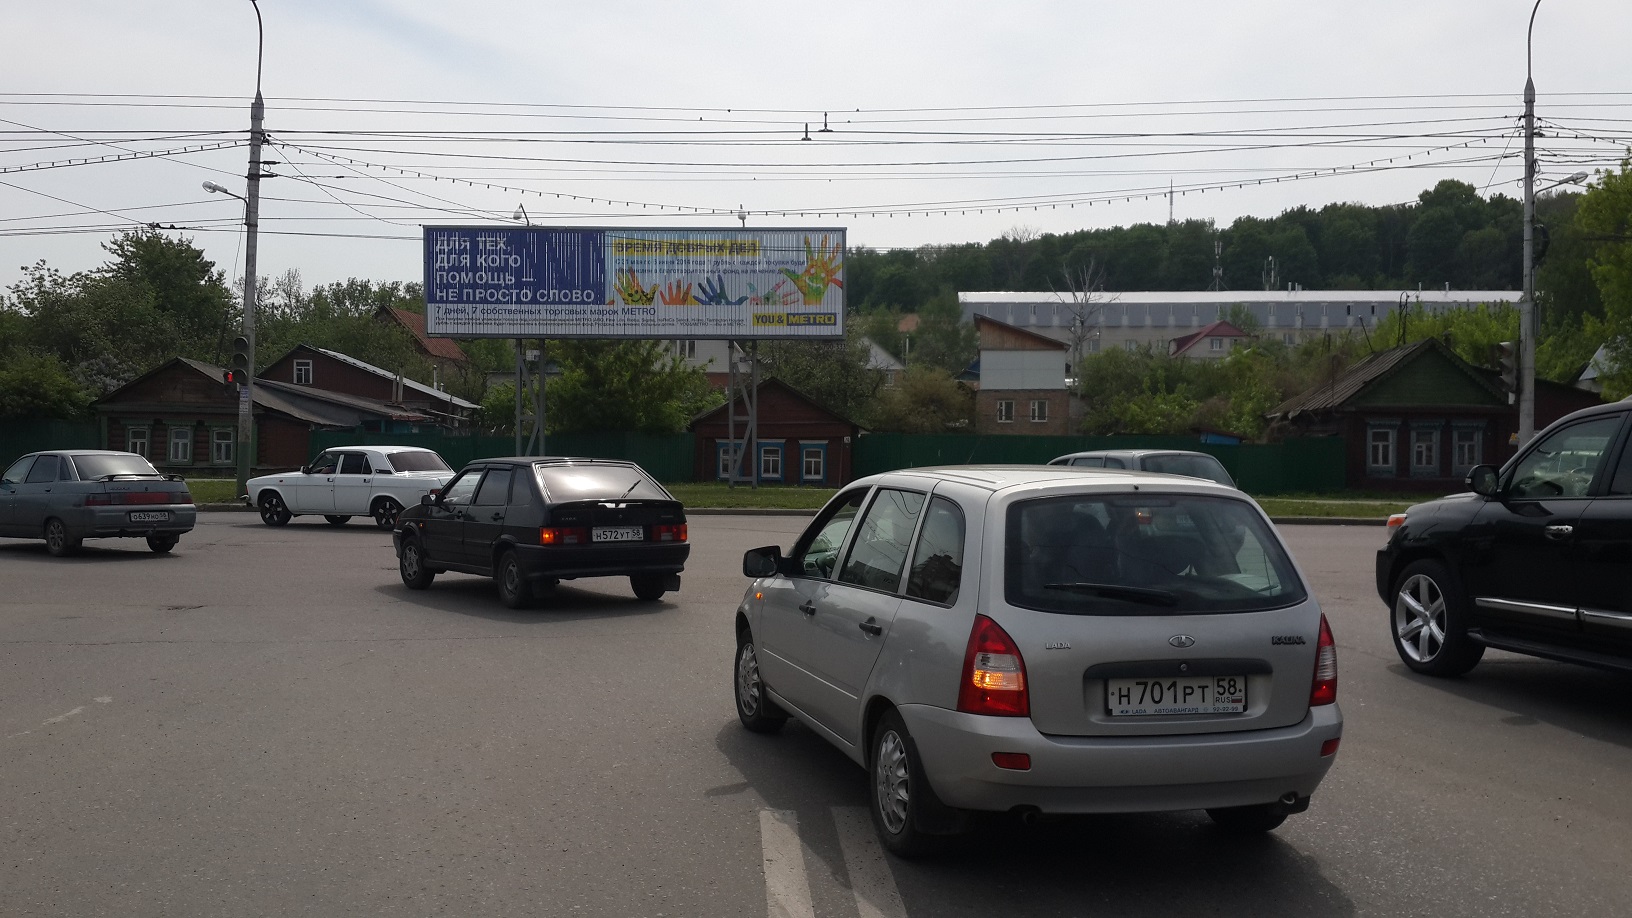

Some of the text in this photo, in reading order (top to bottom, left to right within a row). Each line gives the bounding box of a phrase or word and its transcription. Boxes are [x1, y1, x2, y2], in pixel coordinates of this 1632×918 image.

[435, 237, 511, 252] ДЛЯ ТЕХ,
[435, 254, 521, 269] ДЛЯ КОГО
[436, 271, 516, 286] ПОМОЩЬ
[436, 289, 595, 303] НЕ ПРОСТО СЛОВО
[435, 306, 442, 315] 7
[443, 306, 470, 316] дней,
[472, 306, 478, 315] 7
[480, 307, 542, 316] собственных
[544, 308, 587, 318] торговых
[589, 309, 619, 319] марок
[621, 307, 656, 316] METRO
[755, 314, 774, 324] YOU
[777, 314, 784, 324] &
[788, 314, 835, 324] METRO
[1045, 641, 1071, 650] LADA
[1216, 678, 1238, 696] 58
[1215, 696, 1231, 704] RUS
